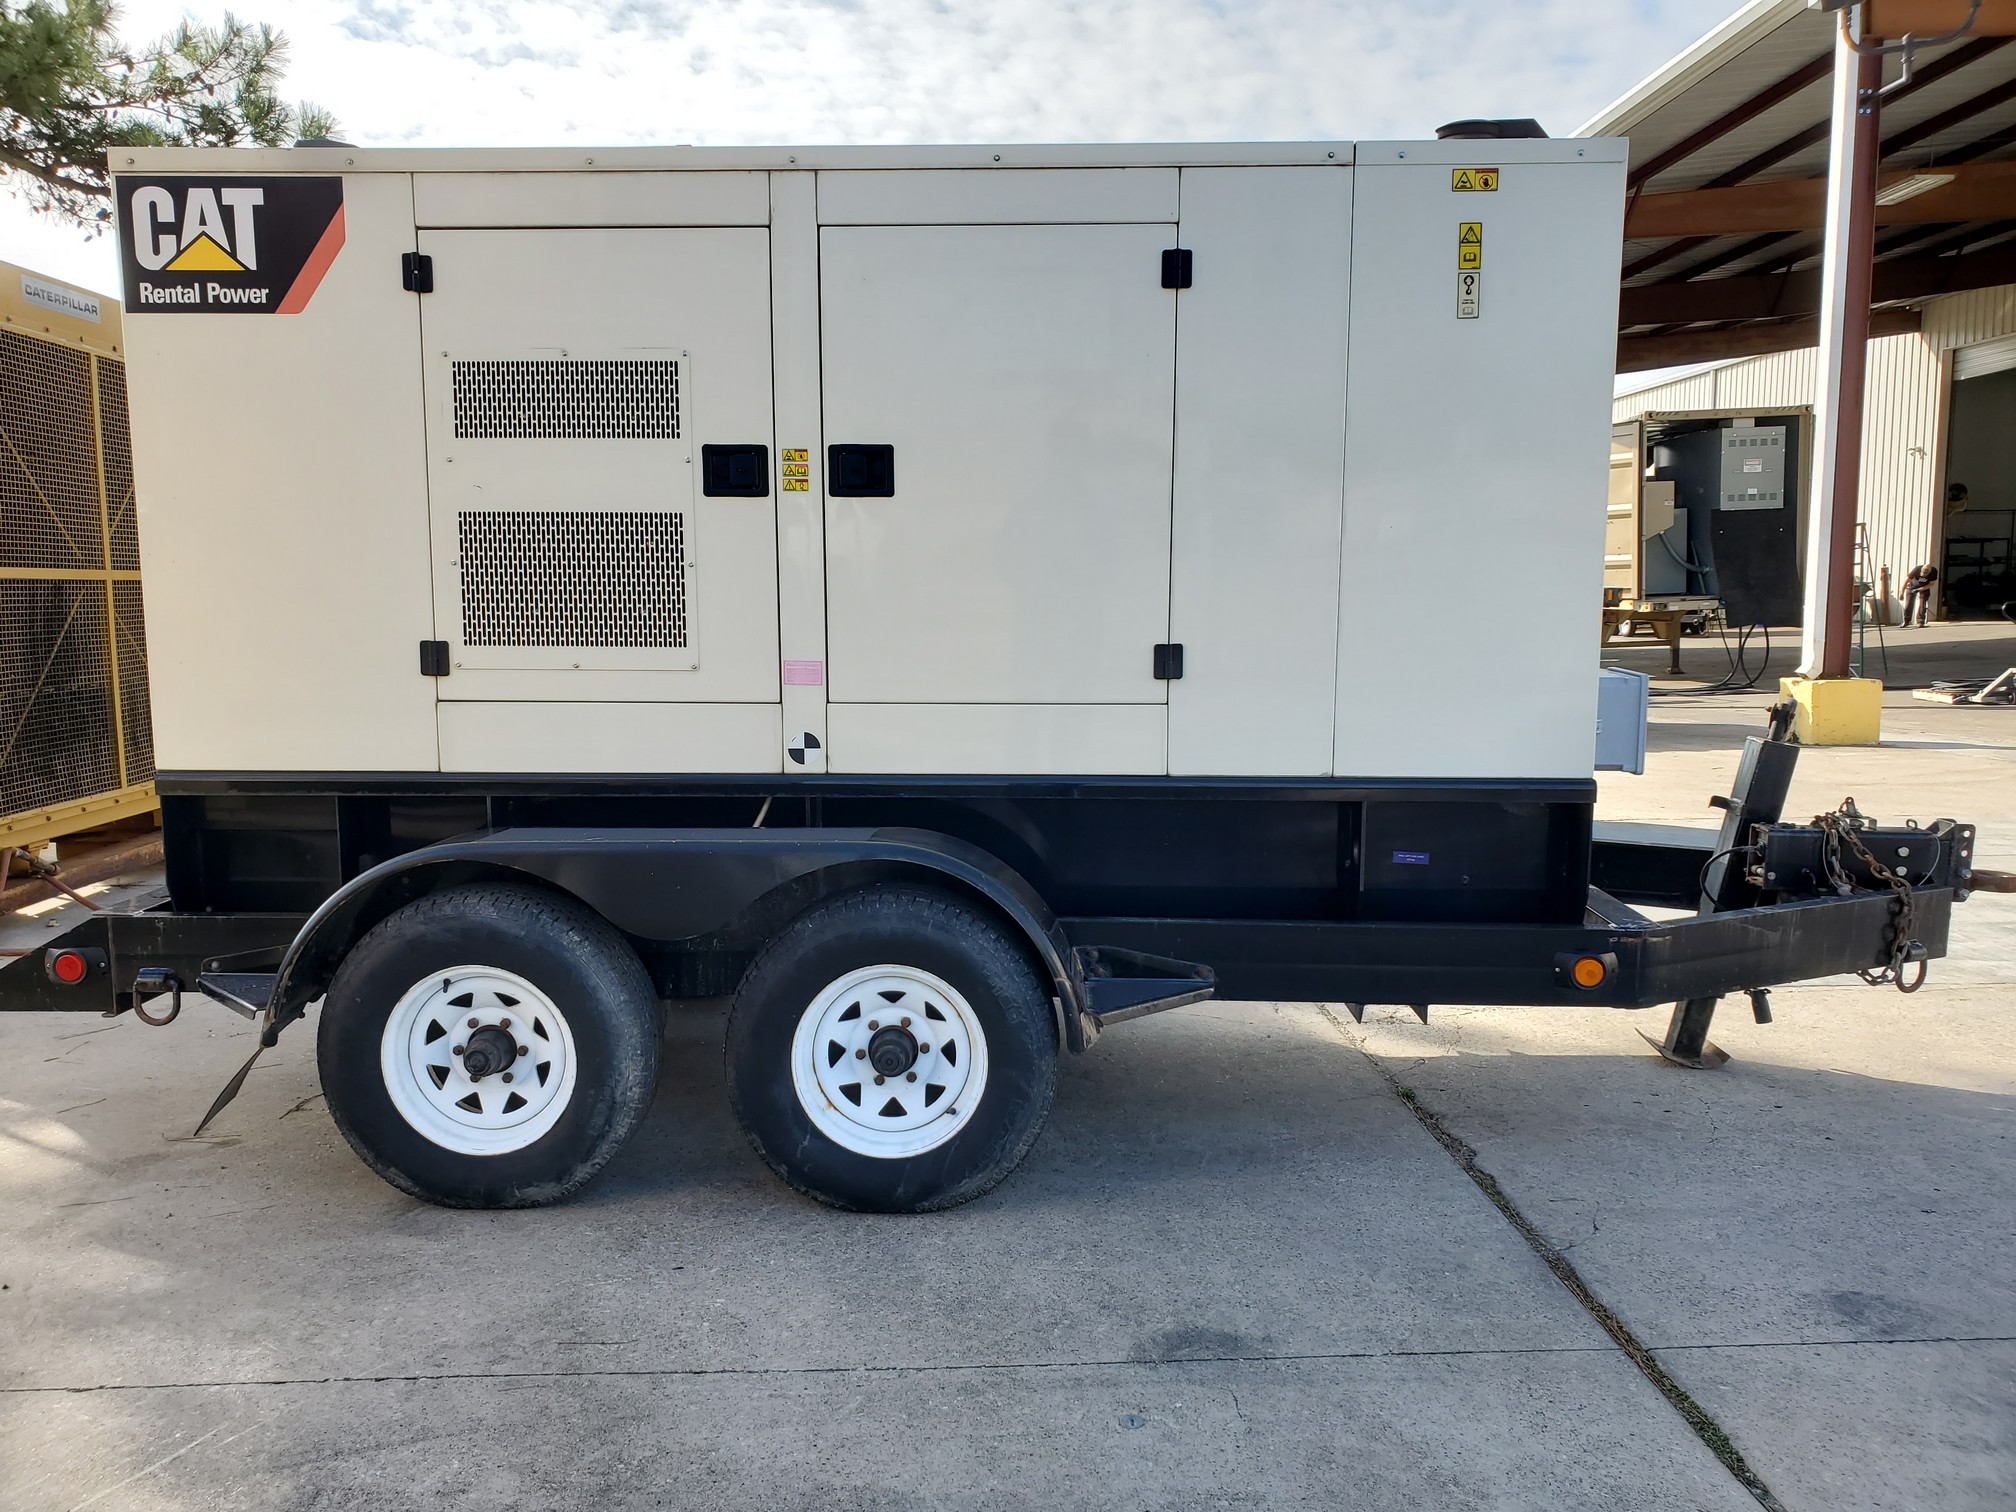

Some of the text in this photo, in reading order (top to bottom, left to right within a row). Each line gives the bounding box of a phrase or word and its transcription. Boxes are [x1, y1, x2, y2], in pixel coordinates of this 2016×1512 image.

[132, 186, 264, 270] CAT
[25, 284, 98, 316] CATERPILLAR
[140, 282, 269, 304] Rental Power
